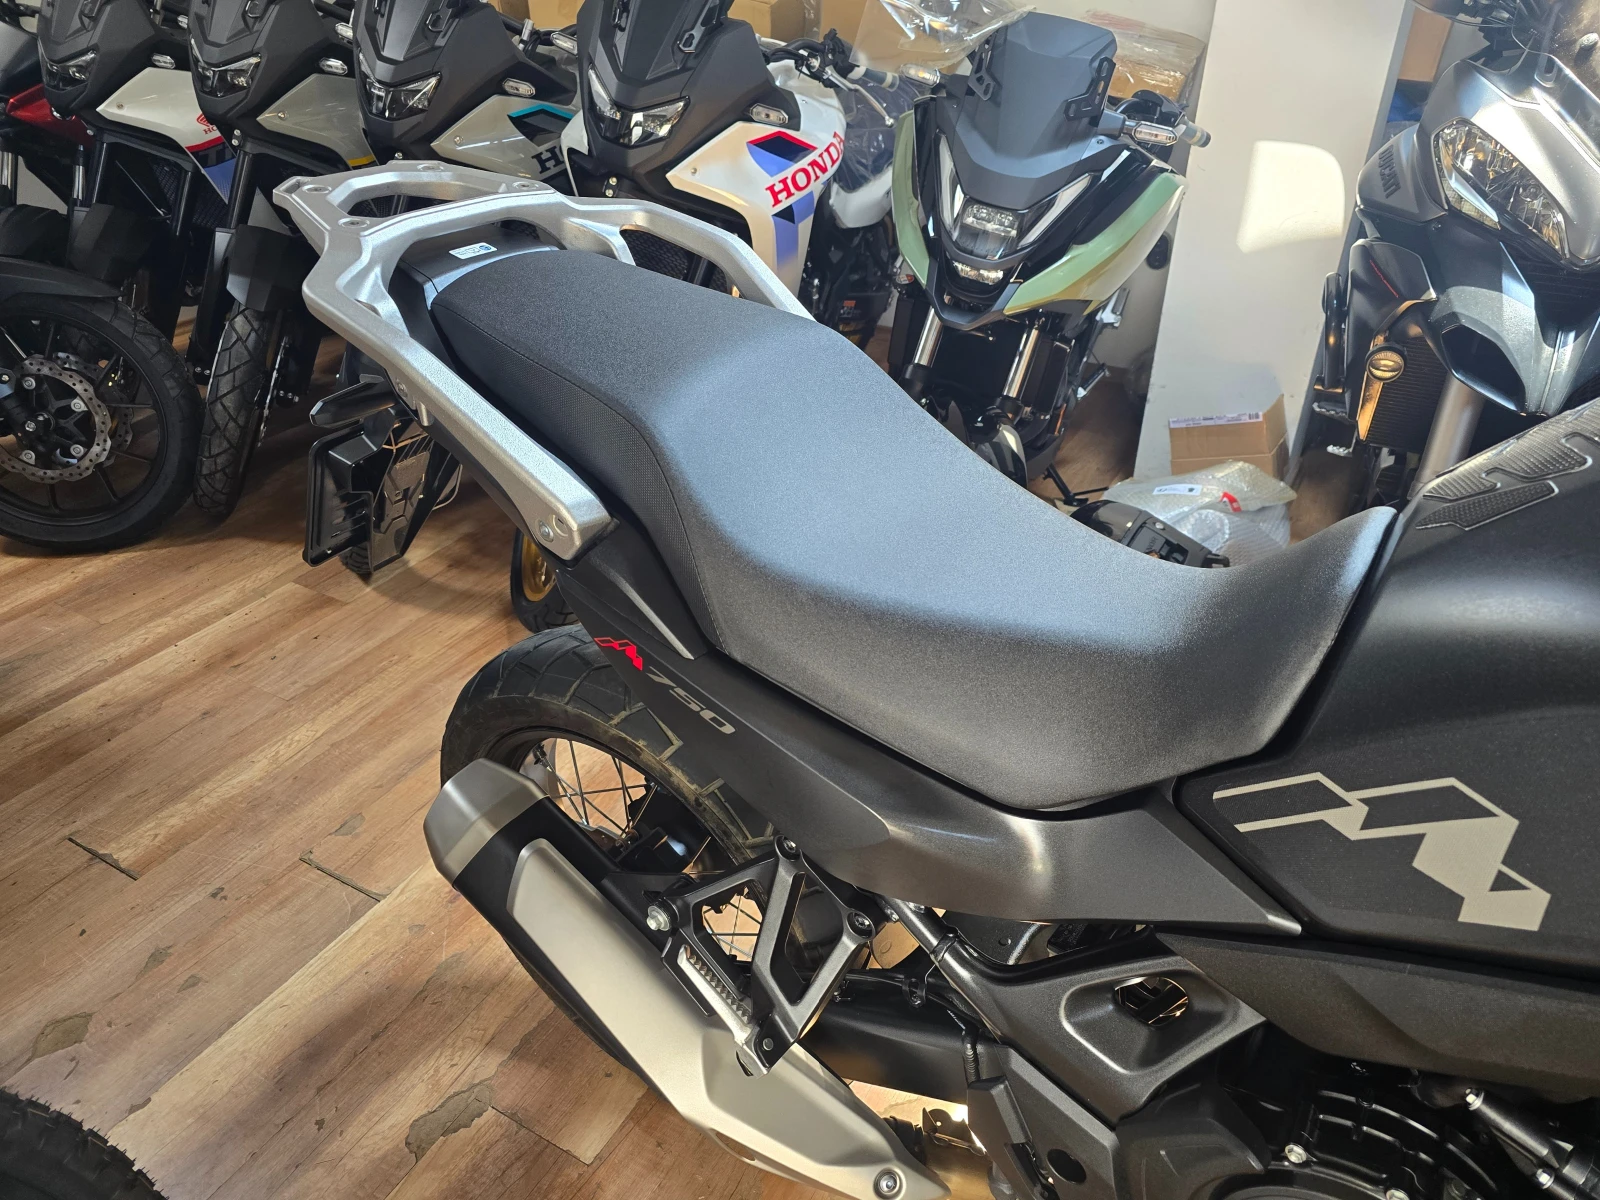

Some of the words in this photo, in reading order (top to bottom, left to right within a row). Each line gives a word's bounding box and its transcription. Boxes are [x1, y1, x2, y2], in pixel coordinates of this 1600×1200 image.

[531, 145, 565, 174] H
[765, 131, 845, 208] HONDA
[1378, 144, 1402, 199] DUCATI
[646, 666, 736, 734] 750
